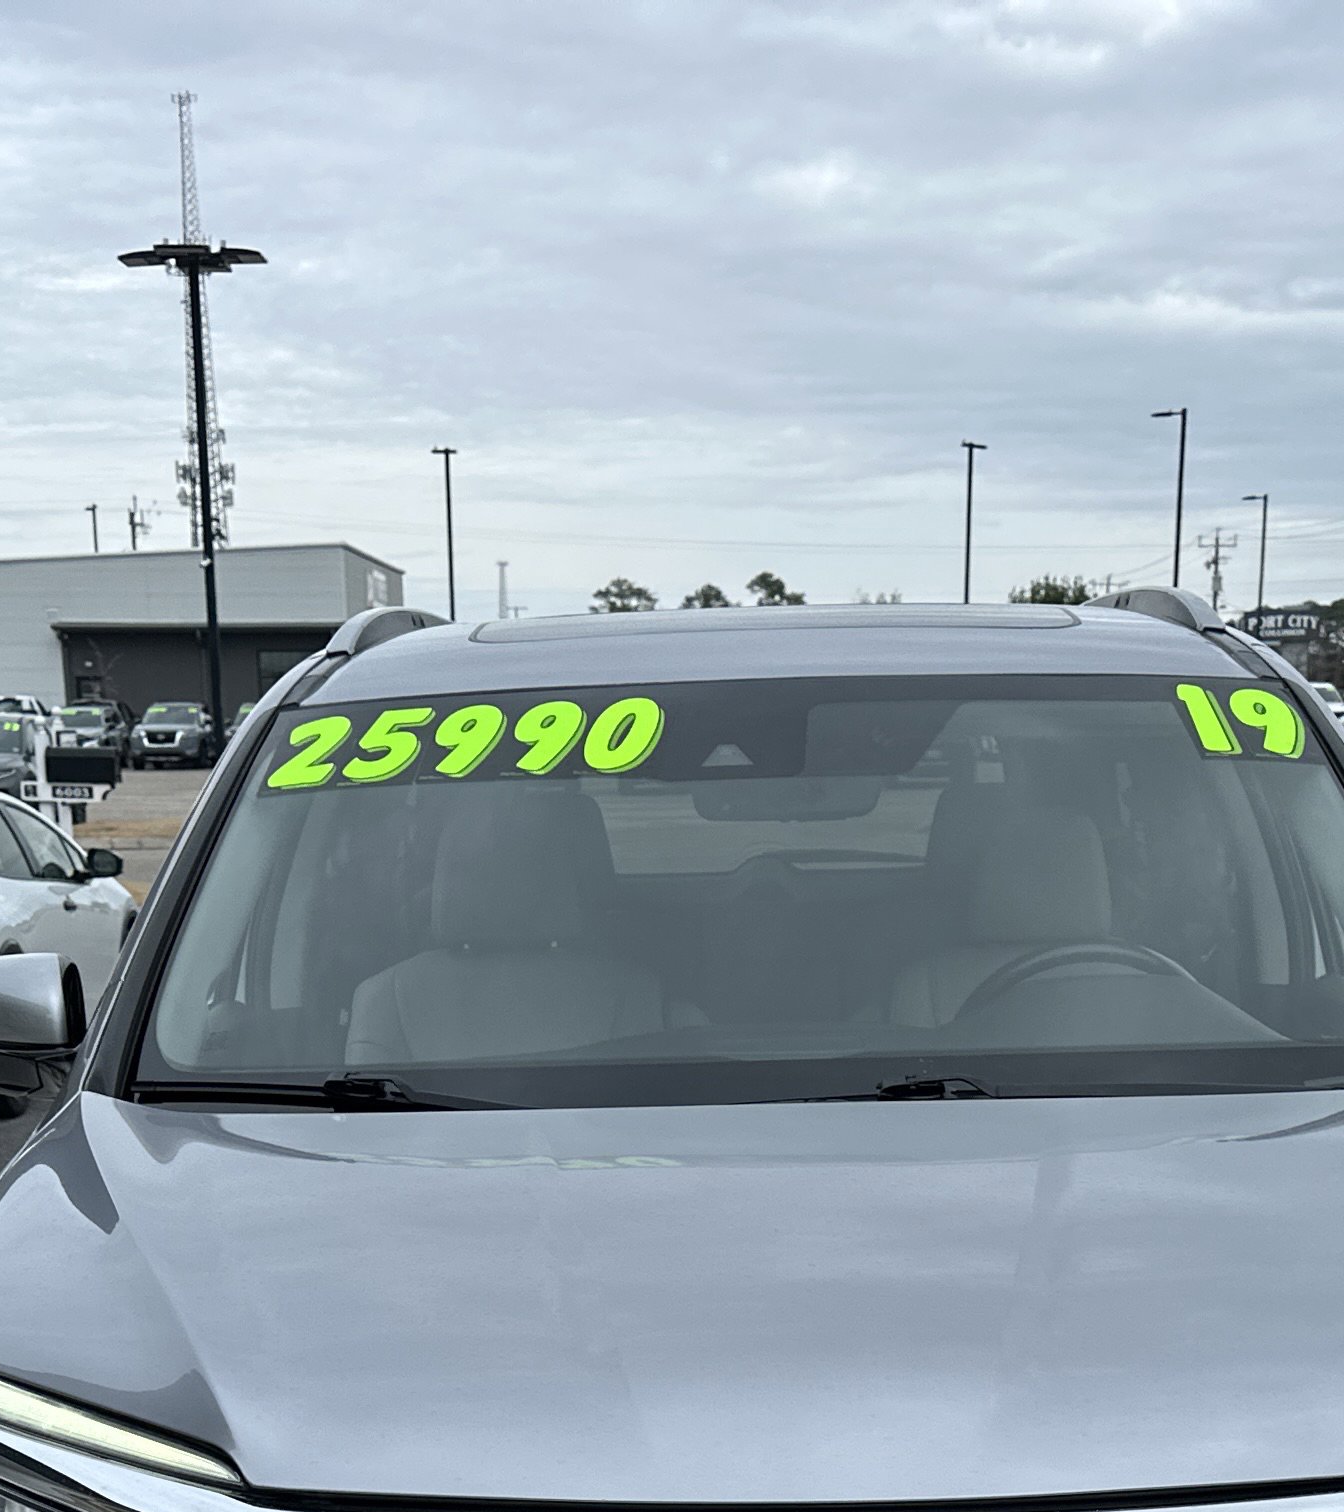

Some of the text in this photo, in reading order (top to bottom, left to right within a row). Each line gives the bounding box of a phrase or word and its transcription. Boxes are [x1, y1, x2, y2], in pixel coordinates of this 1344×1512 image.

[1287, 614, 1319, 630] CITY
[267, 683, 1305, 789] 25990 19
